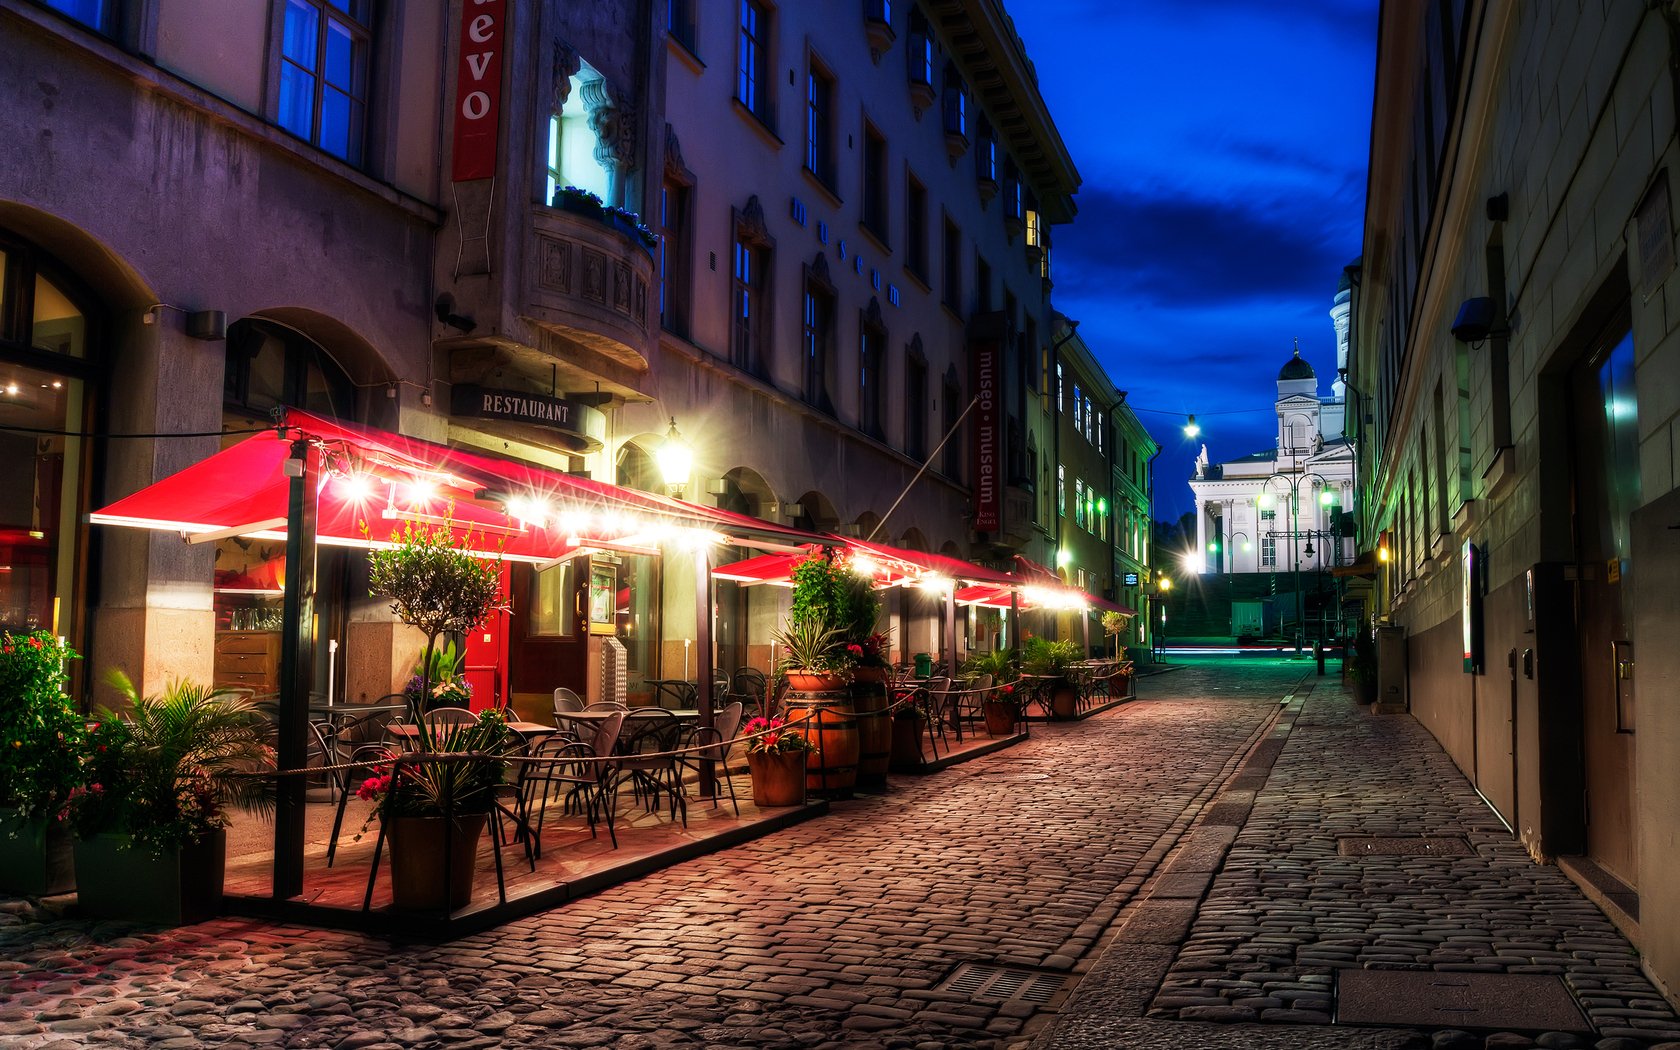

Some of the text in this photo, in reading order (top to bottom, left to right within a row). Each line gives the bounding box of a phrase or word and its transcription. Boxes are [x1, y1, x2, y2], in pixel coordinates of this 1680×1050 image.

[462, 0, 497, 120] evo
[791, 197, 901, 309] museum
[482, 393, 569, 423] RESTAURANT
[979, 351, 993, 504] museo museum
